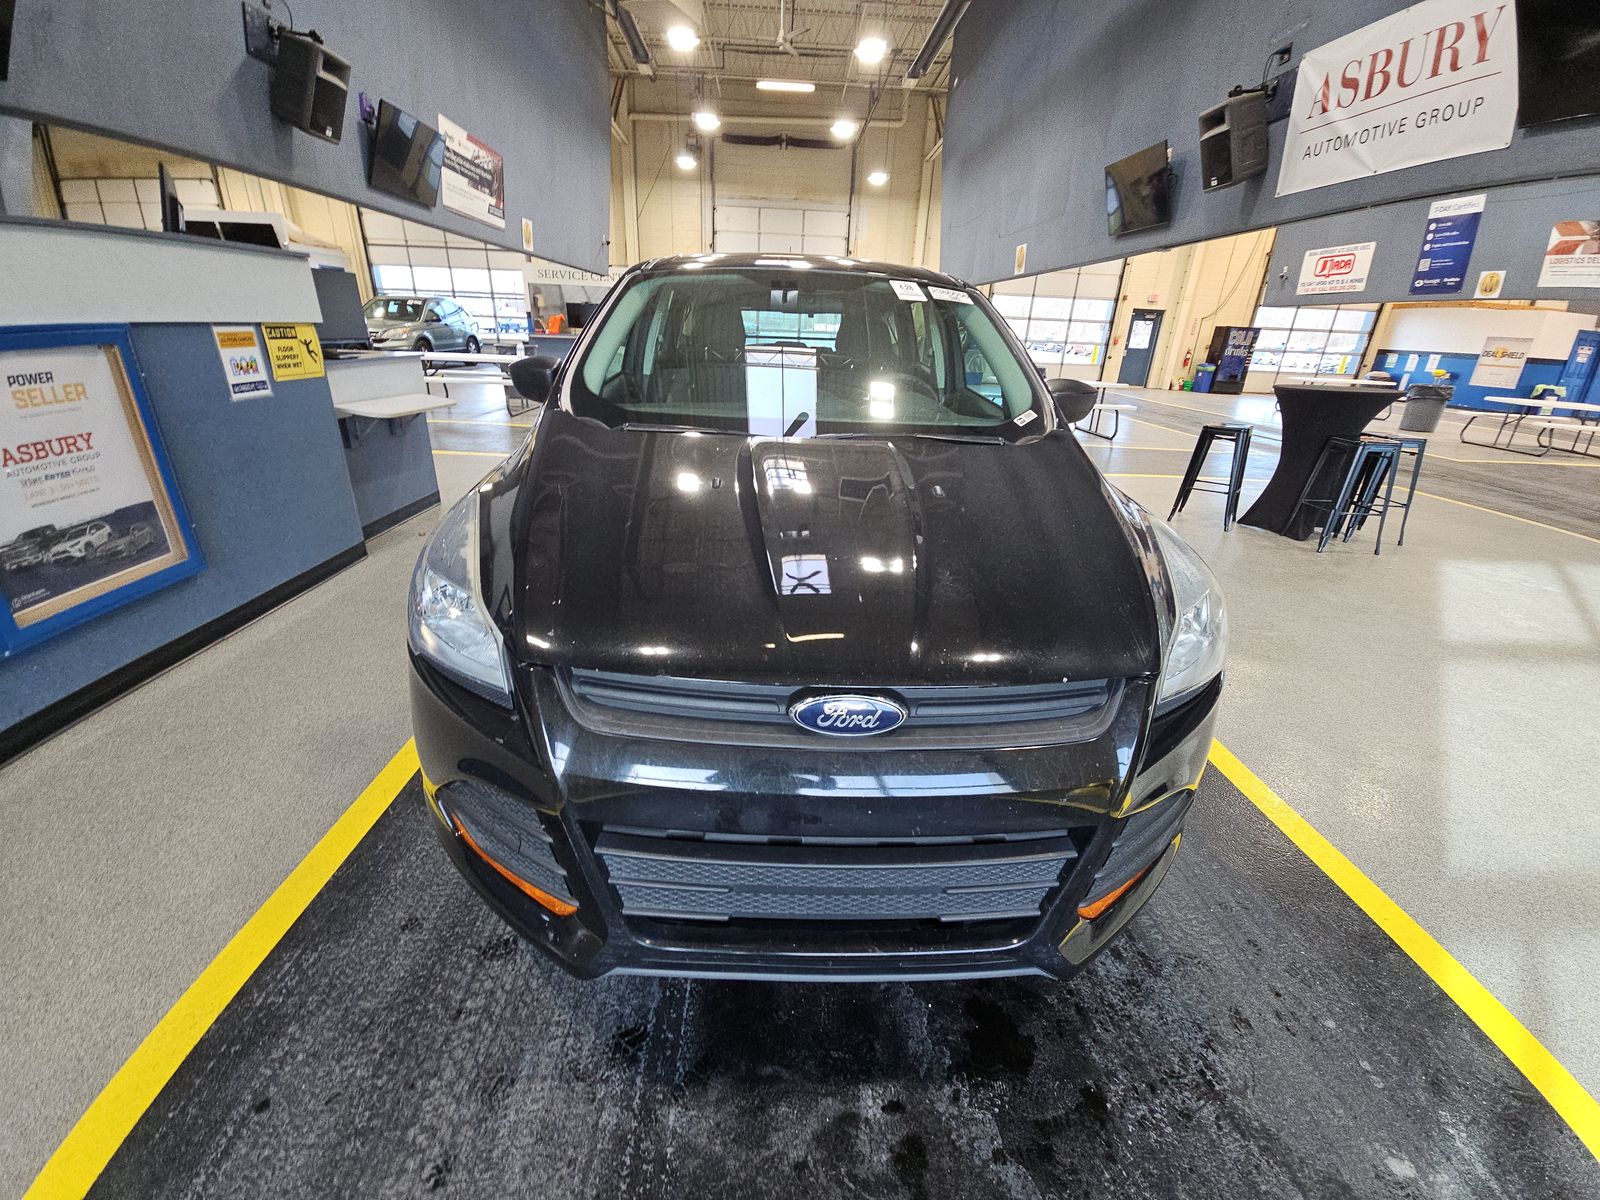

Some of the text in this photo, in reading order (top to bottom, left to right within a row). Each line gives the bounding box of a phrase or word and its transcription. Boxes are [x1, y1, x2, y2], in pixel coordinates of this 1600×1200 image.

[1306, 5, 1507, 120] ASBURY
[1302, 97, 1485, 160] AUTOMOTIVE GROUP
[1549, 257, 1585, 265] LOGISTICS
[537, 268, 588, 281] SERVICE
[266, 327, 297, 339] CAUTION
[277, 345, 294, 353] FLOOR
[1224, 346, 1249, 357] drinks
[1482, 350, 1525, 360] DEAL SHIELD
[275, 353, 299, 361] SLIPPERY
[7, 371, 54, 388] POWER
[11, 382, 88, 410] SELLER
[2, 432, 93, 468] ASBURY
[6, 457, 67, 479] AUTOMOTIVE
[70, 451, 101, 465] GROUP
[816, 702, 882, 728] Ford
